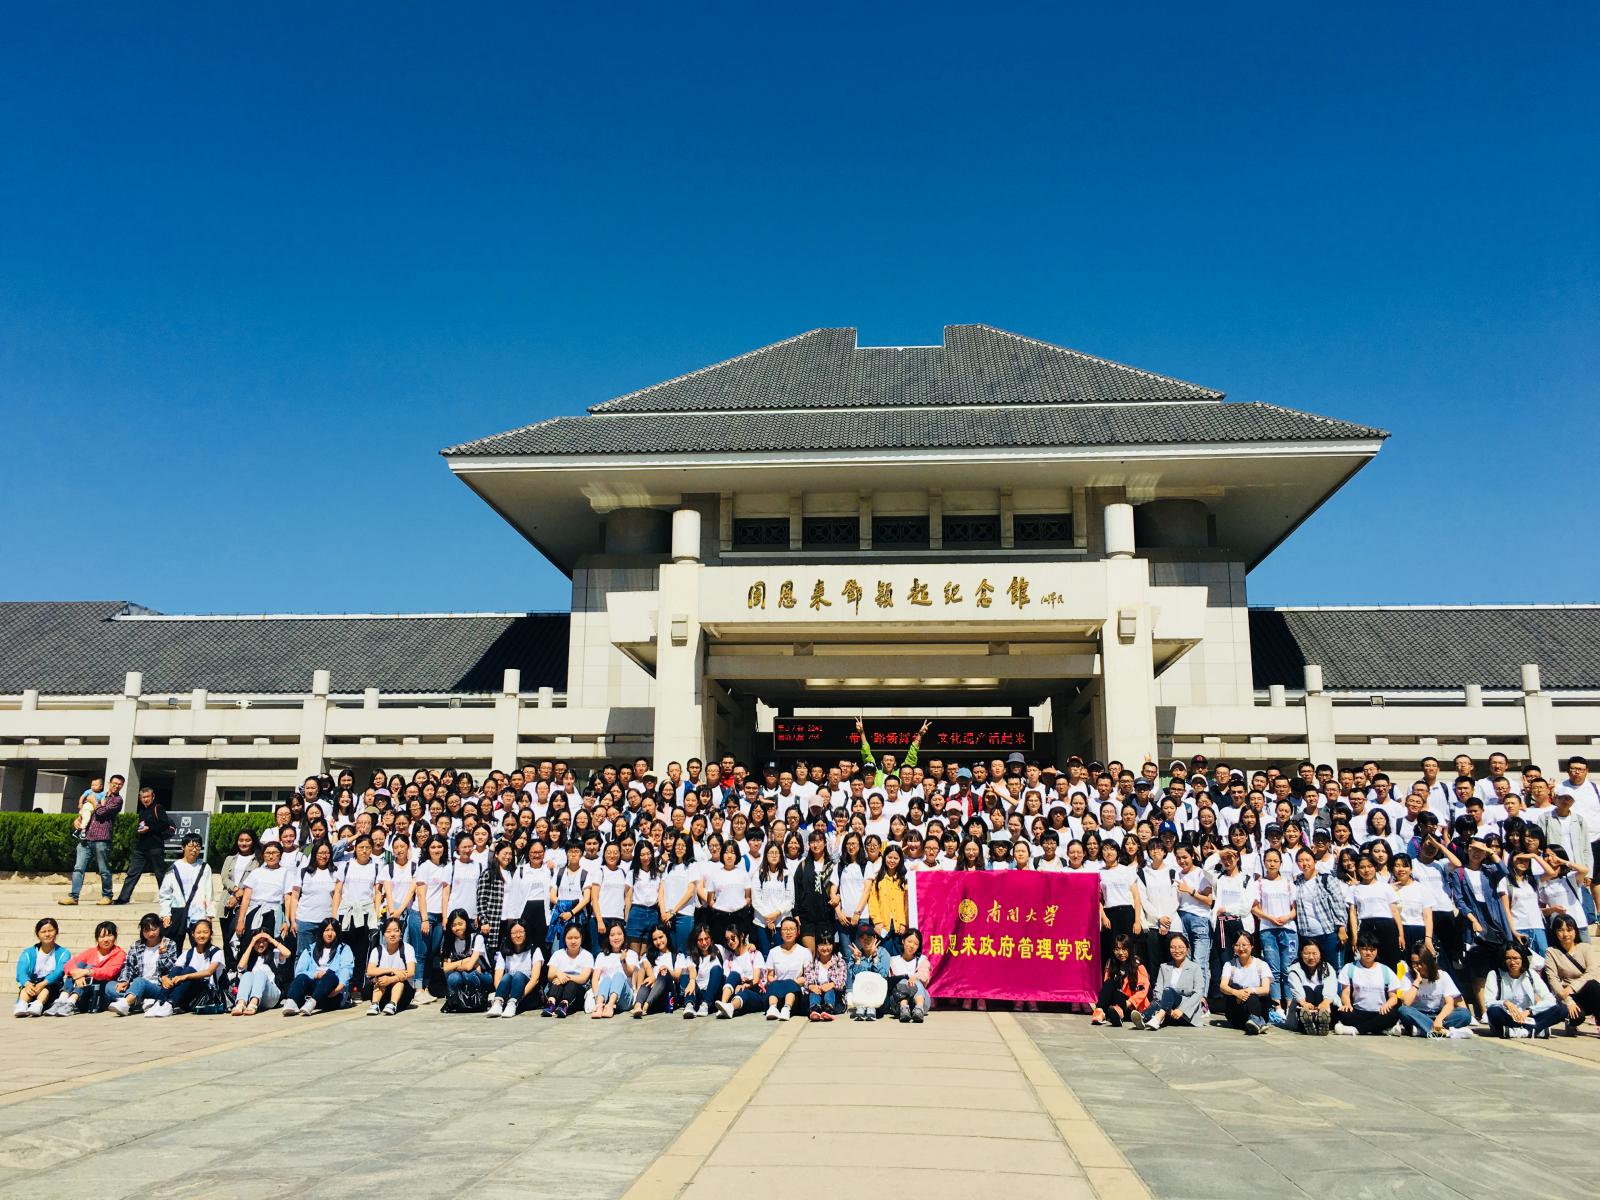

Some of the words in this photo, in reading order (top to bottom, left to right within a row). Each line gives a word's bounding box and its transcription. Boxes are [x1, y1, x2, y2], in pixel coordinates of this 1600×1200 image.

[928, 933, 1093, 961] 周恩来政府管理学院
